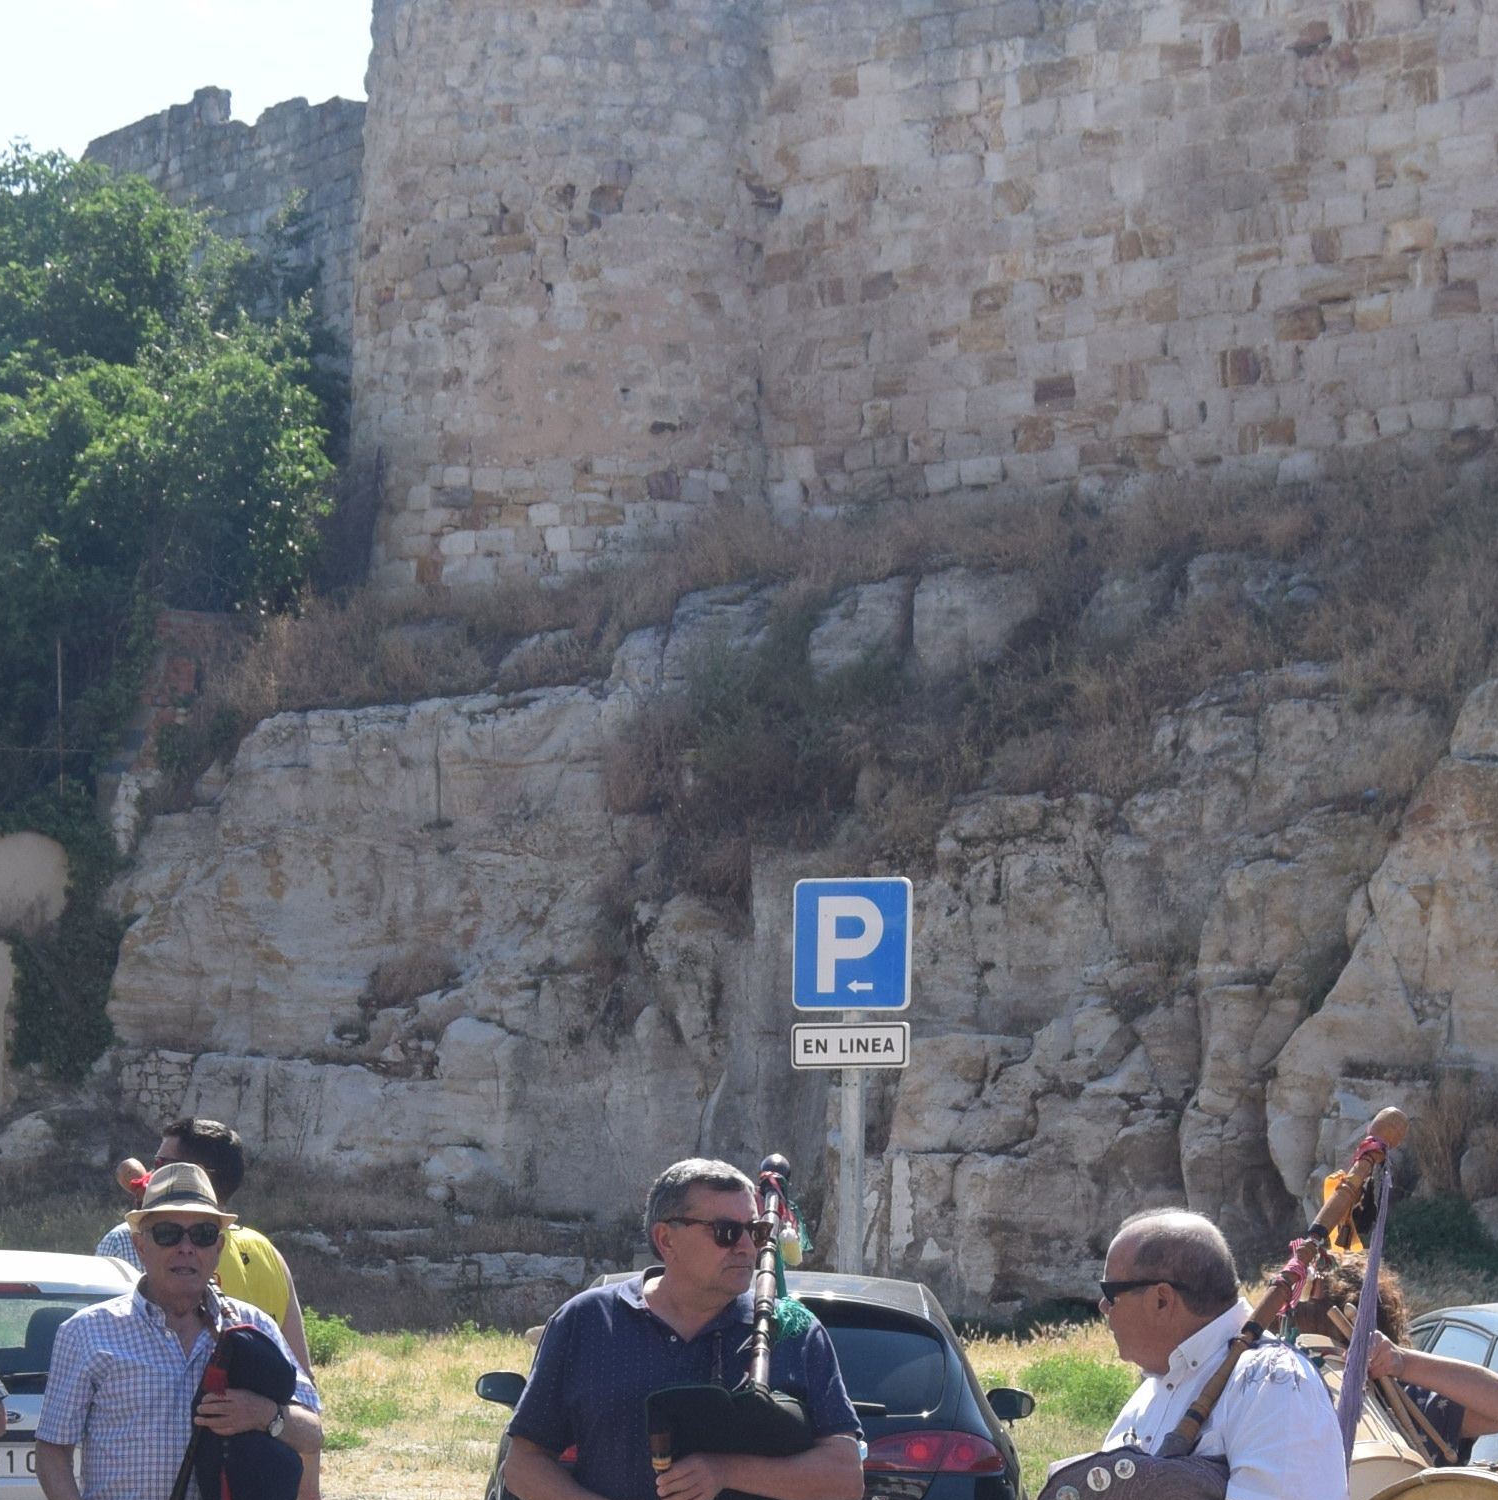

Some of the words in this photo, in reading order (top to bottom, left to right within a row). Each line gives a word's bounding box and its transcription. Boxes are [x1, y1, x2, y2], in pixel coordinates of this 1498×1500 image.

[817, 895, 884, 993] P
[803, 1038, 828, 1054] EN
[839, 1037, 895, 1053] LINEA
